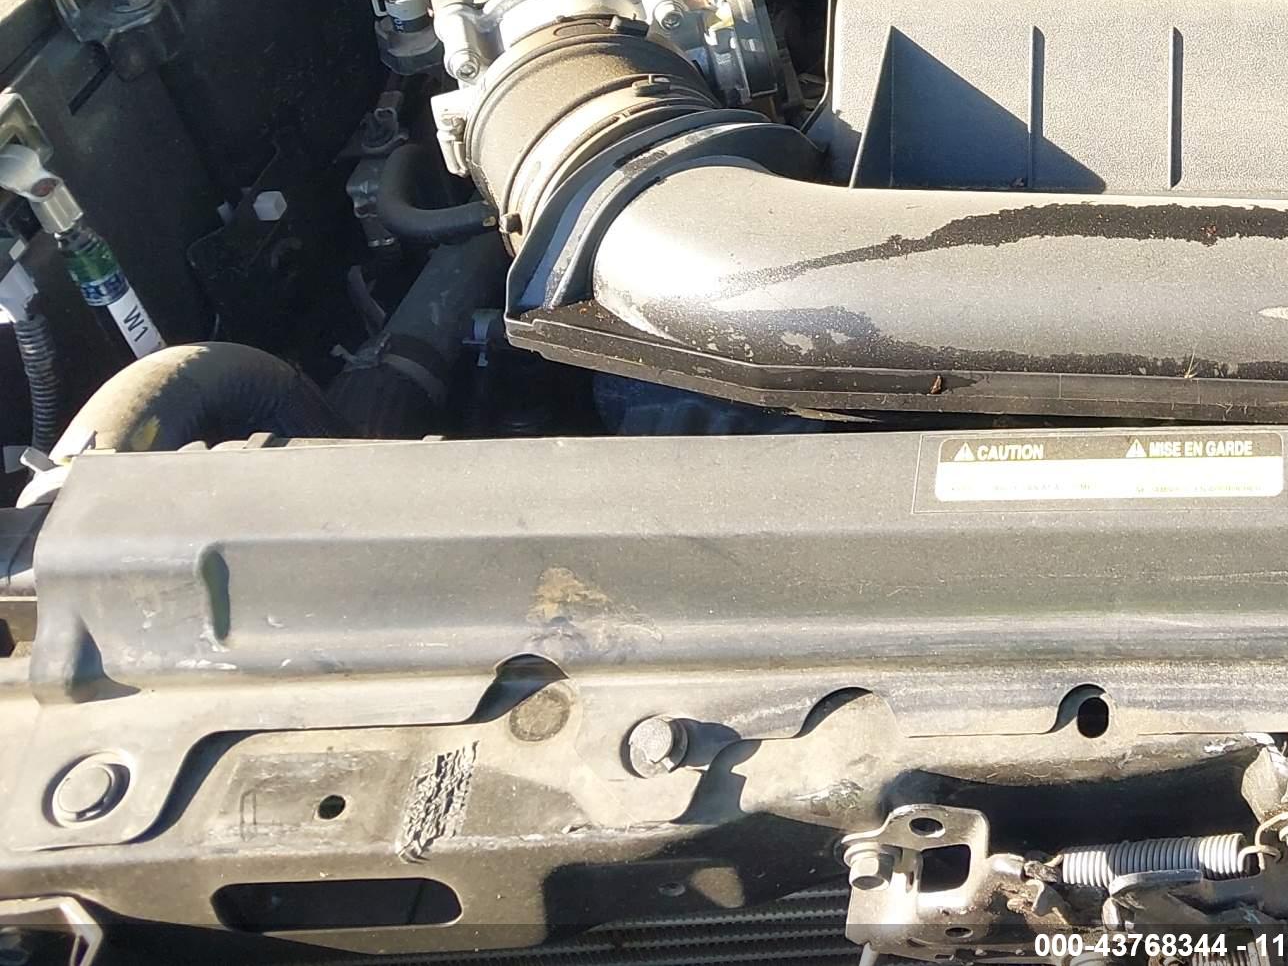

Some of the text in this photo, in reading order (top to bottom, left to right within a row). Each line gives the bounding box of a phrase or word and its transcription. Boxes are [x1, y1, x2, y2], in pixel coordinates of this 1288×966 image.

[976, 440, 1253, 460] CAUTION MISE EN GARDE
